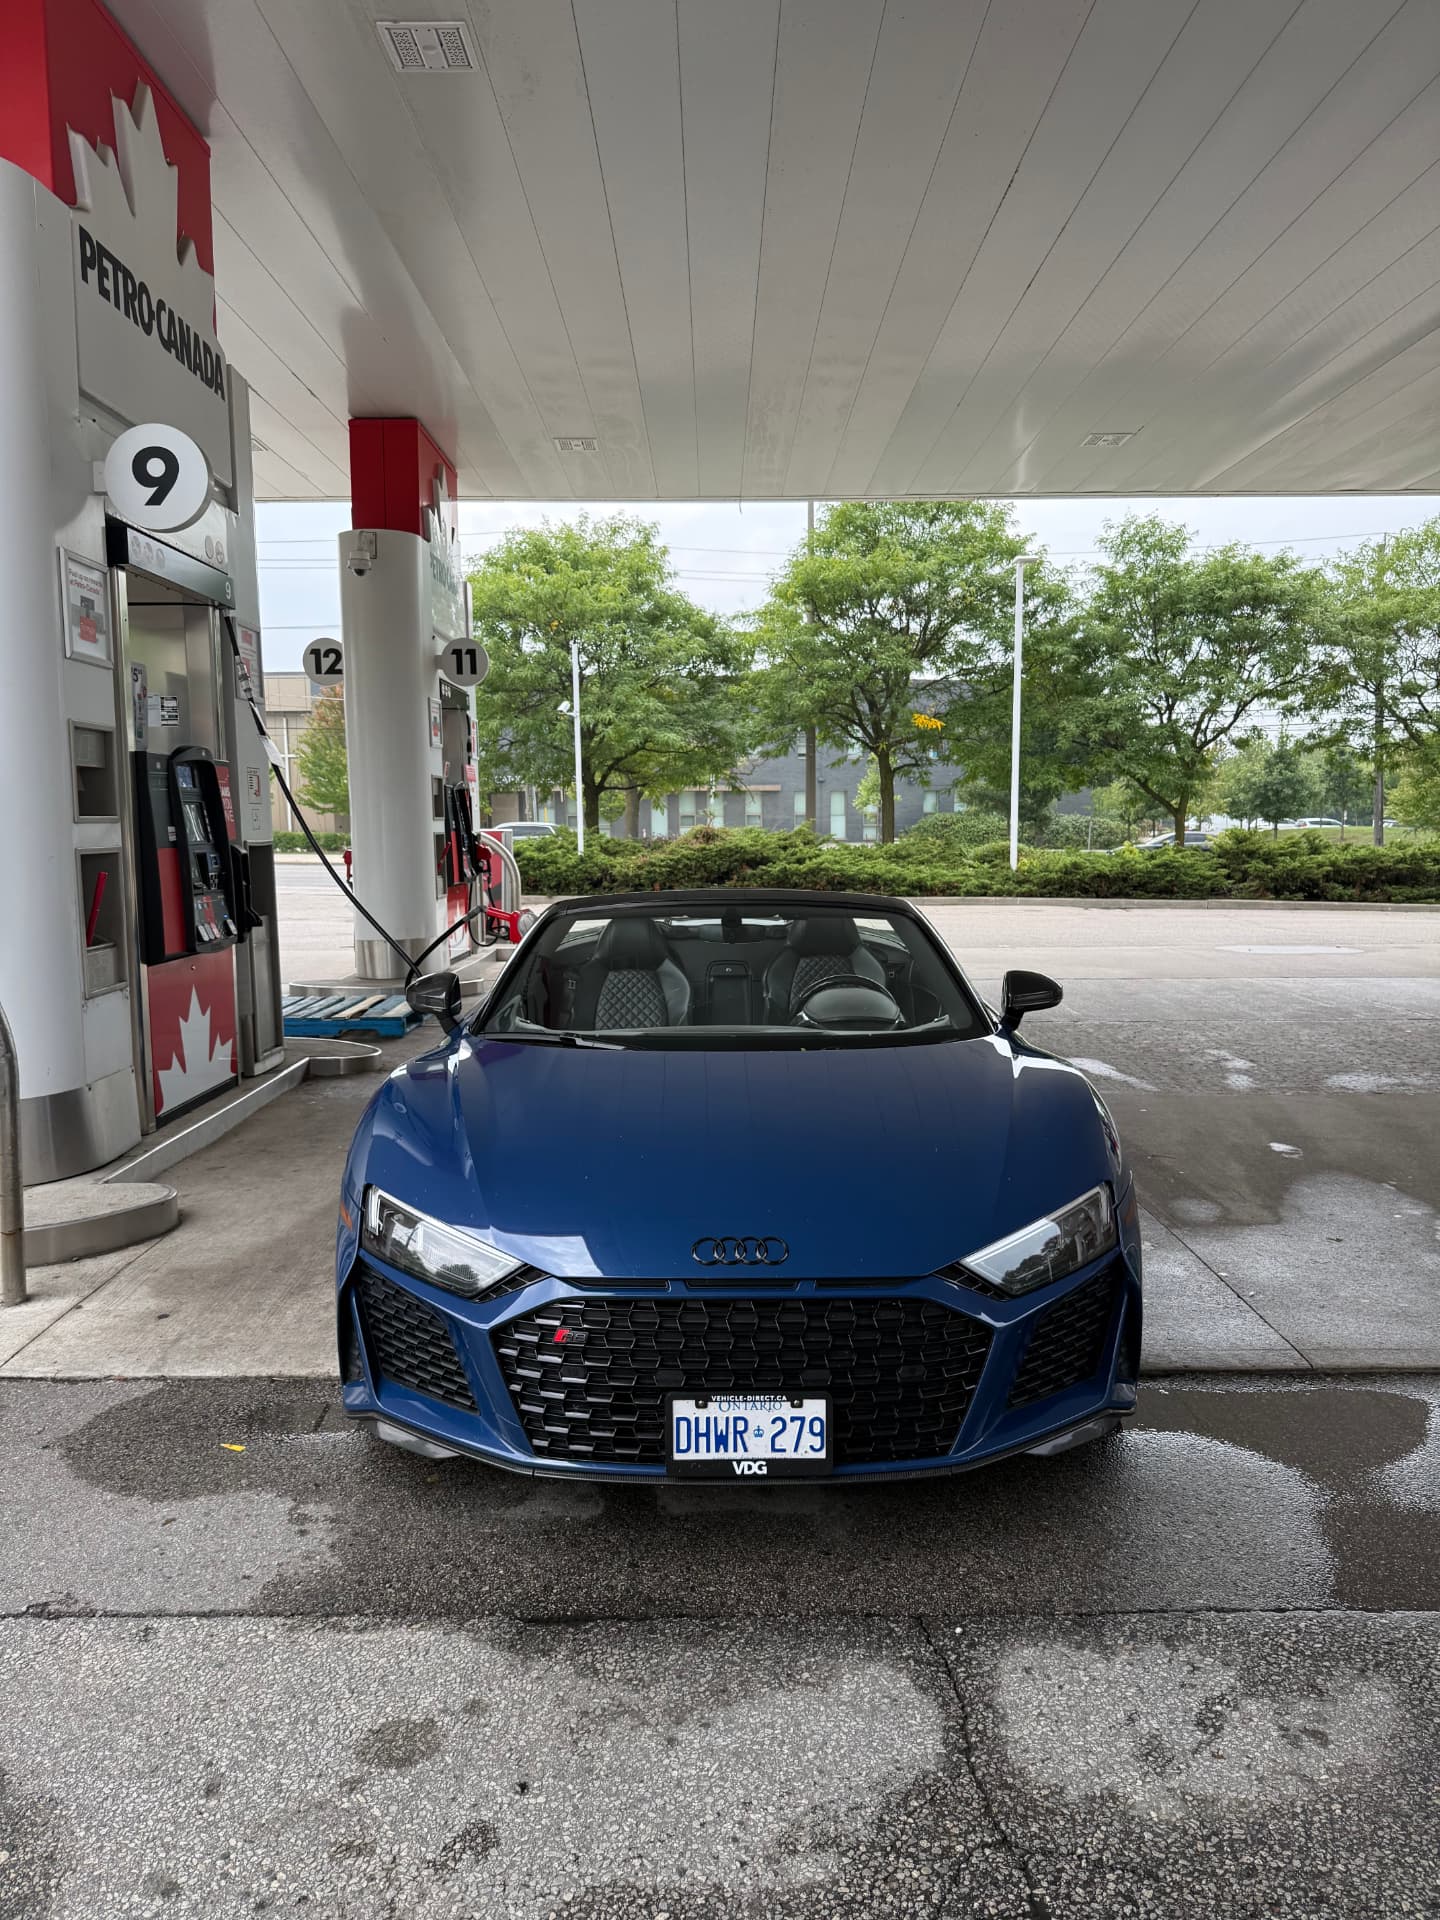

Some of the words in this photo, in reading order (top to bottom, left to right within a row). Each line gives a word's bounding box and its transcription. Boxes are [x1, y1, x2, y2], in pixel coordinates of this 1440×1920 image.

[79, 224, 226, 402] PETRO-CANADA
[132, 446, 180, 506] 9
[225, 581, 232, 600] 9
[309, 648, 343, 675] 12
[451, 648, 478, 675] 11
[719, 1401, 783, 1412] ONTARIO
[675, 1416, 749, 1453] DHWR
[770, 1416, 825, 1453] 279
[732, 1461, 768, 1475] VDG
